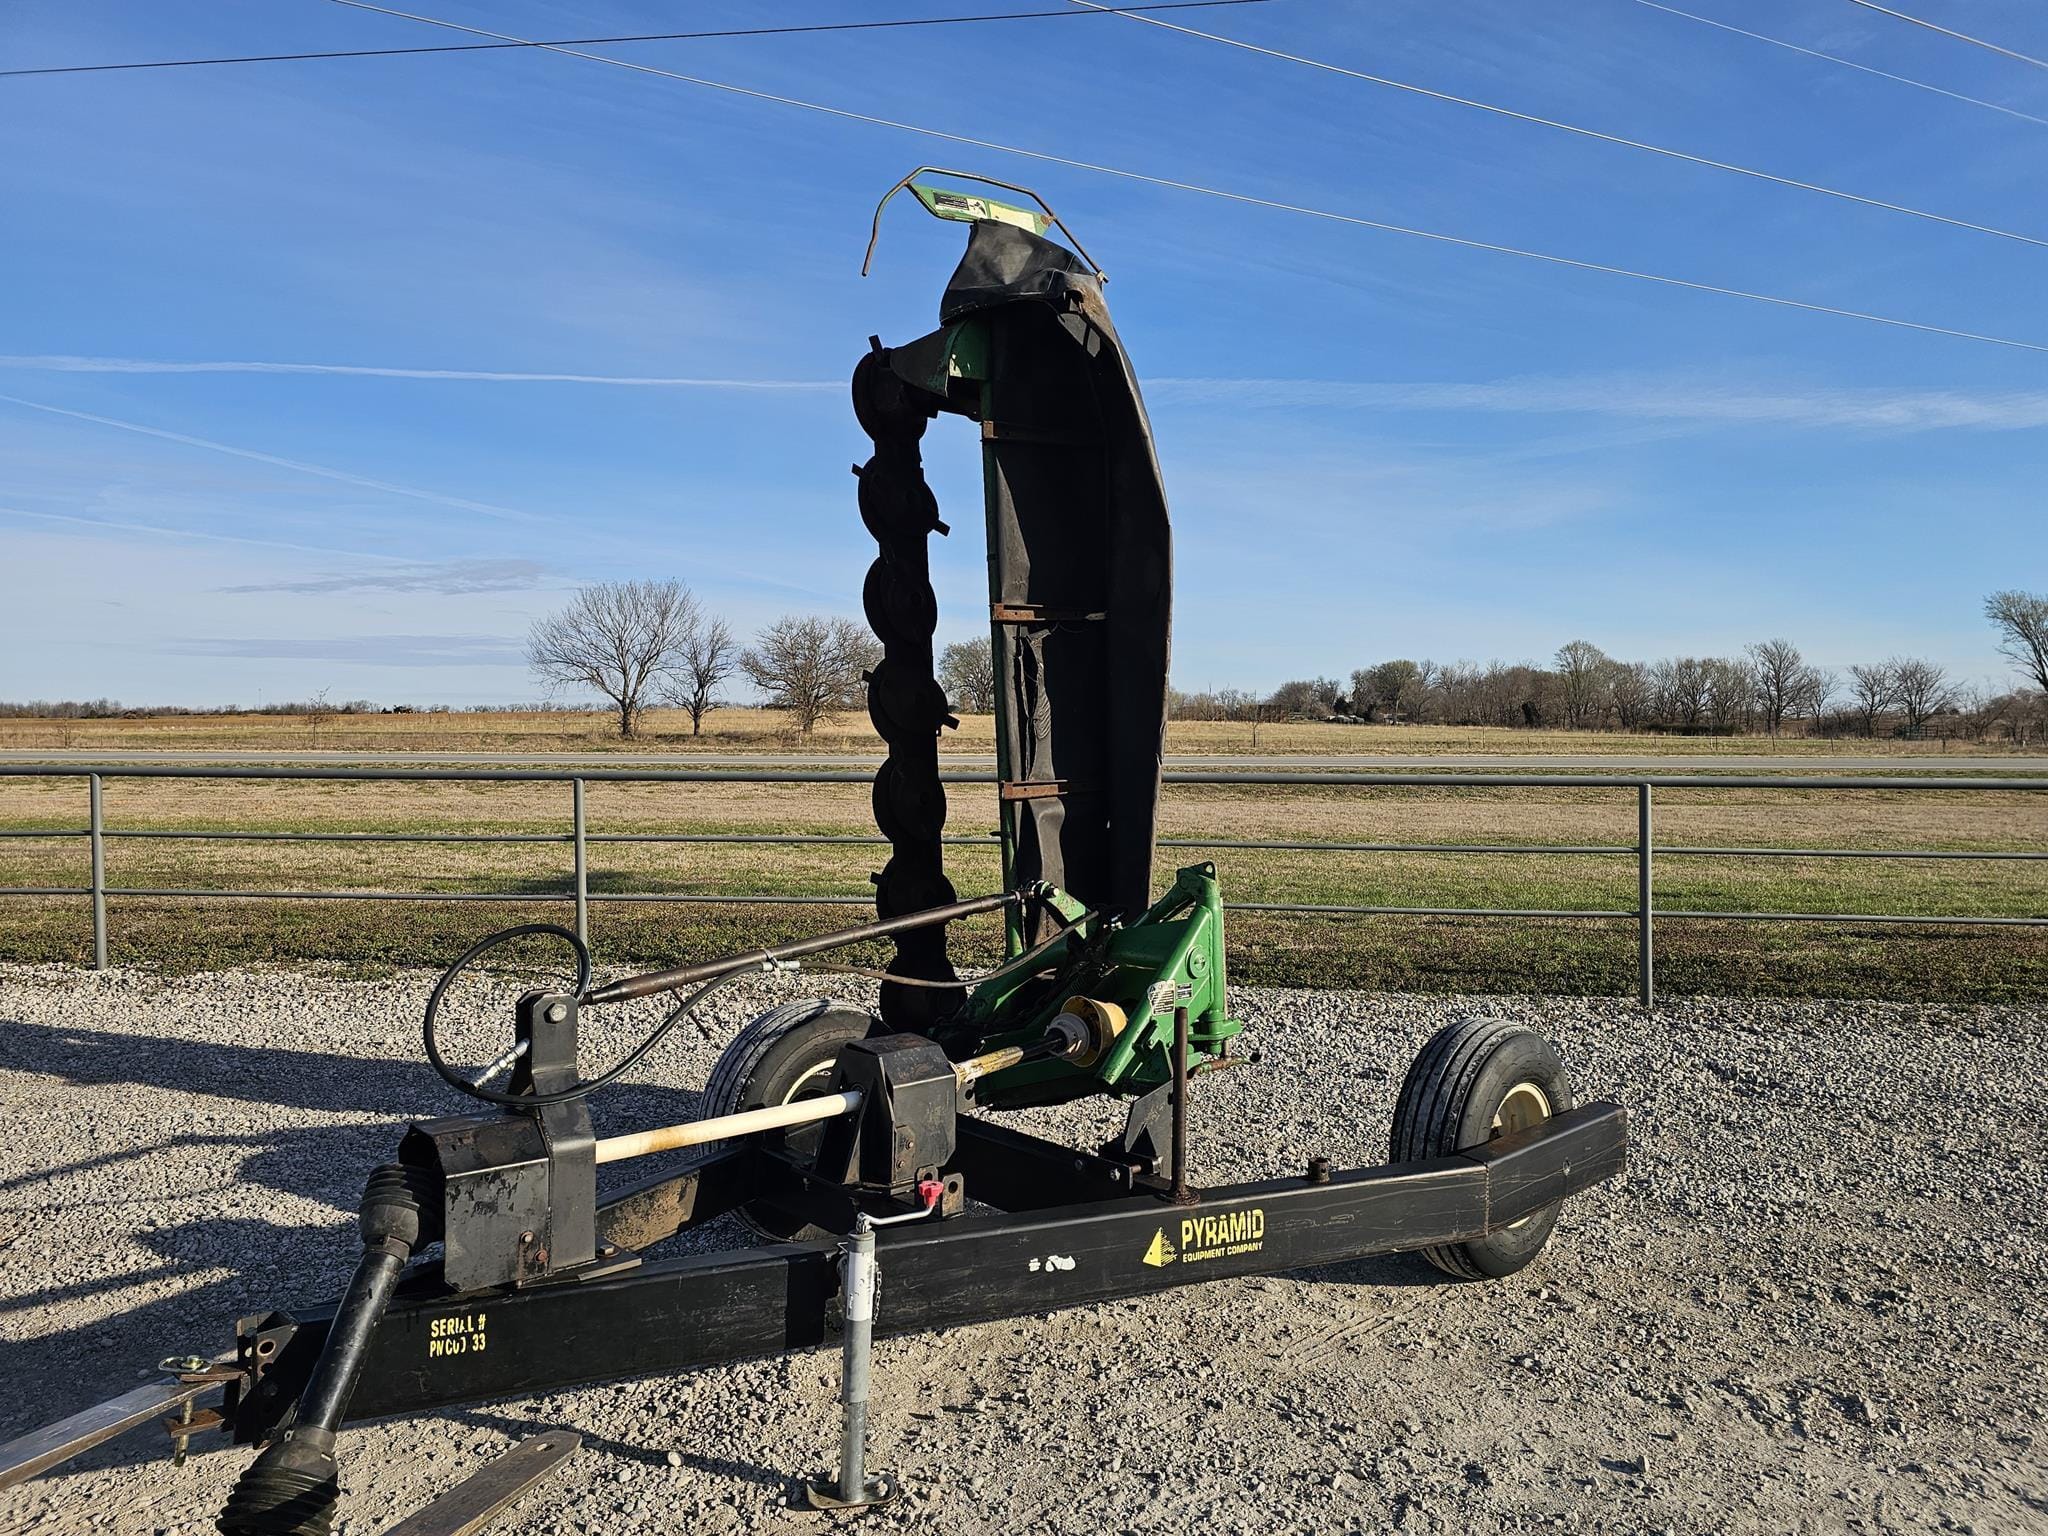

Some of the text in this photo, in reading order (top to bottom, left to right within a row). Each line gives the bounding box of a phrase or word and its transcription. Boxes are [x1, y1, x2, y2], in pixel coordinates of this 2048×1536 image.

[1181, 1208, 1265, 1250] PYRAMID
[1182, 1240, 1263, 1263] EQUIPMENT COMPANY
[430, 1313, 487, 1338] SERIAL #
